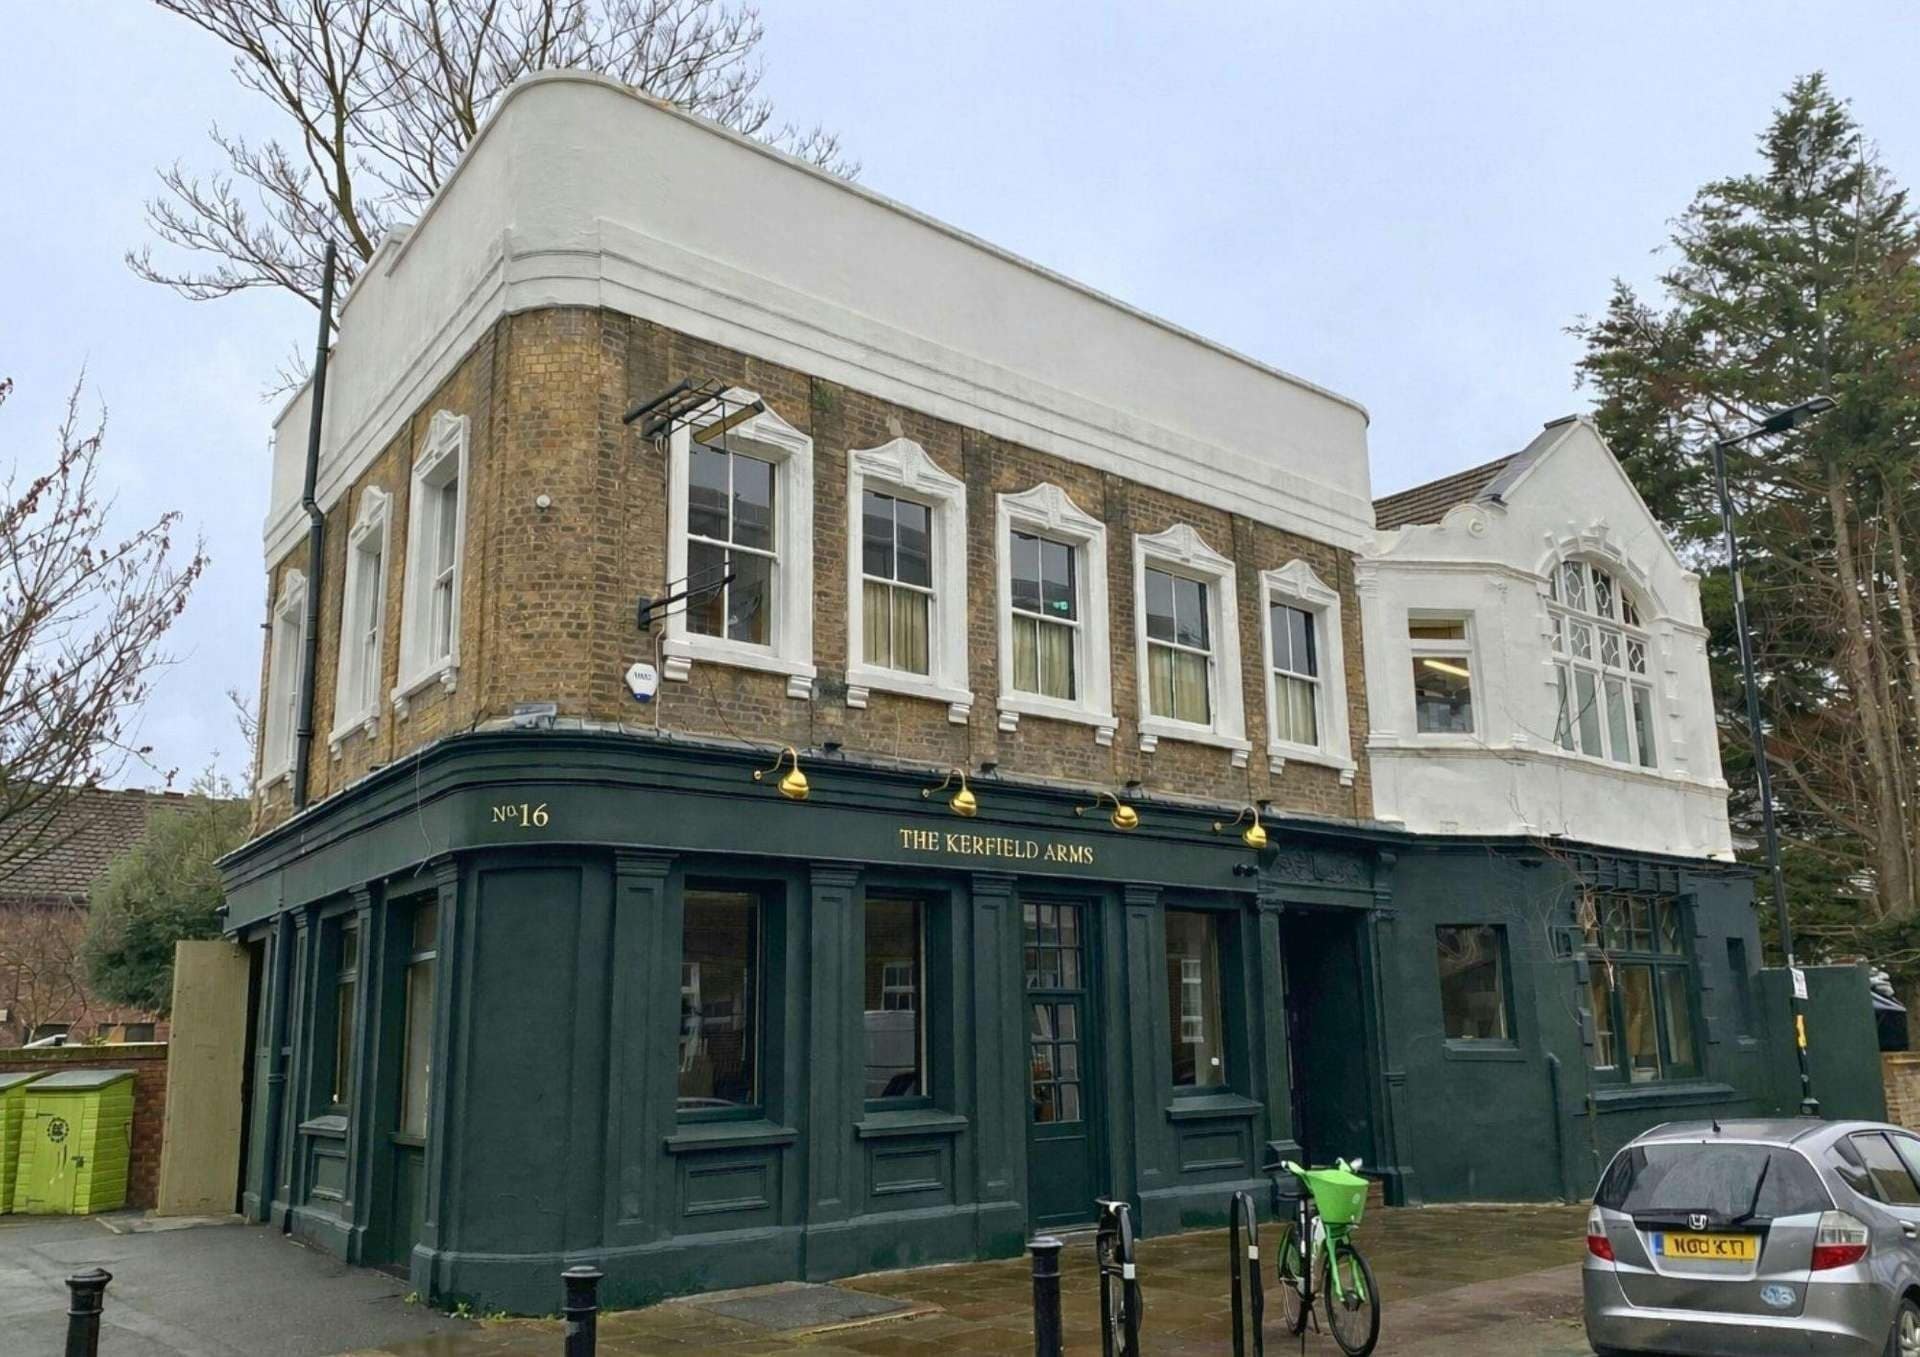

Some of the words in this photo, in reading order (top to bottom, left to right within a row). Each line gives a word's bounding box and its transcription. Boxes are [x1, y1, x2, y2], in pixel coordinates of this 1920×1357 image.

[519, 803, 549, 827] 16
[900, 828, 939, 851] THE
[946, 833, 1039, 860] KERFIELD
[1043, 843, 1094, 865] ARMS
